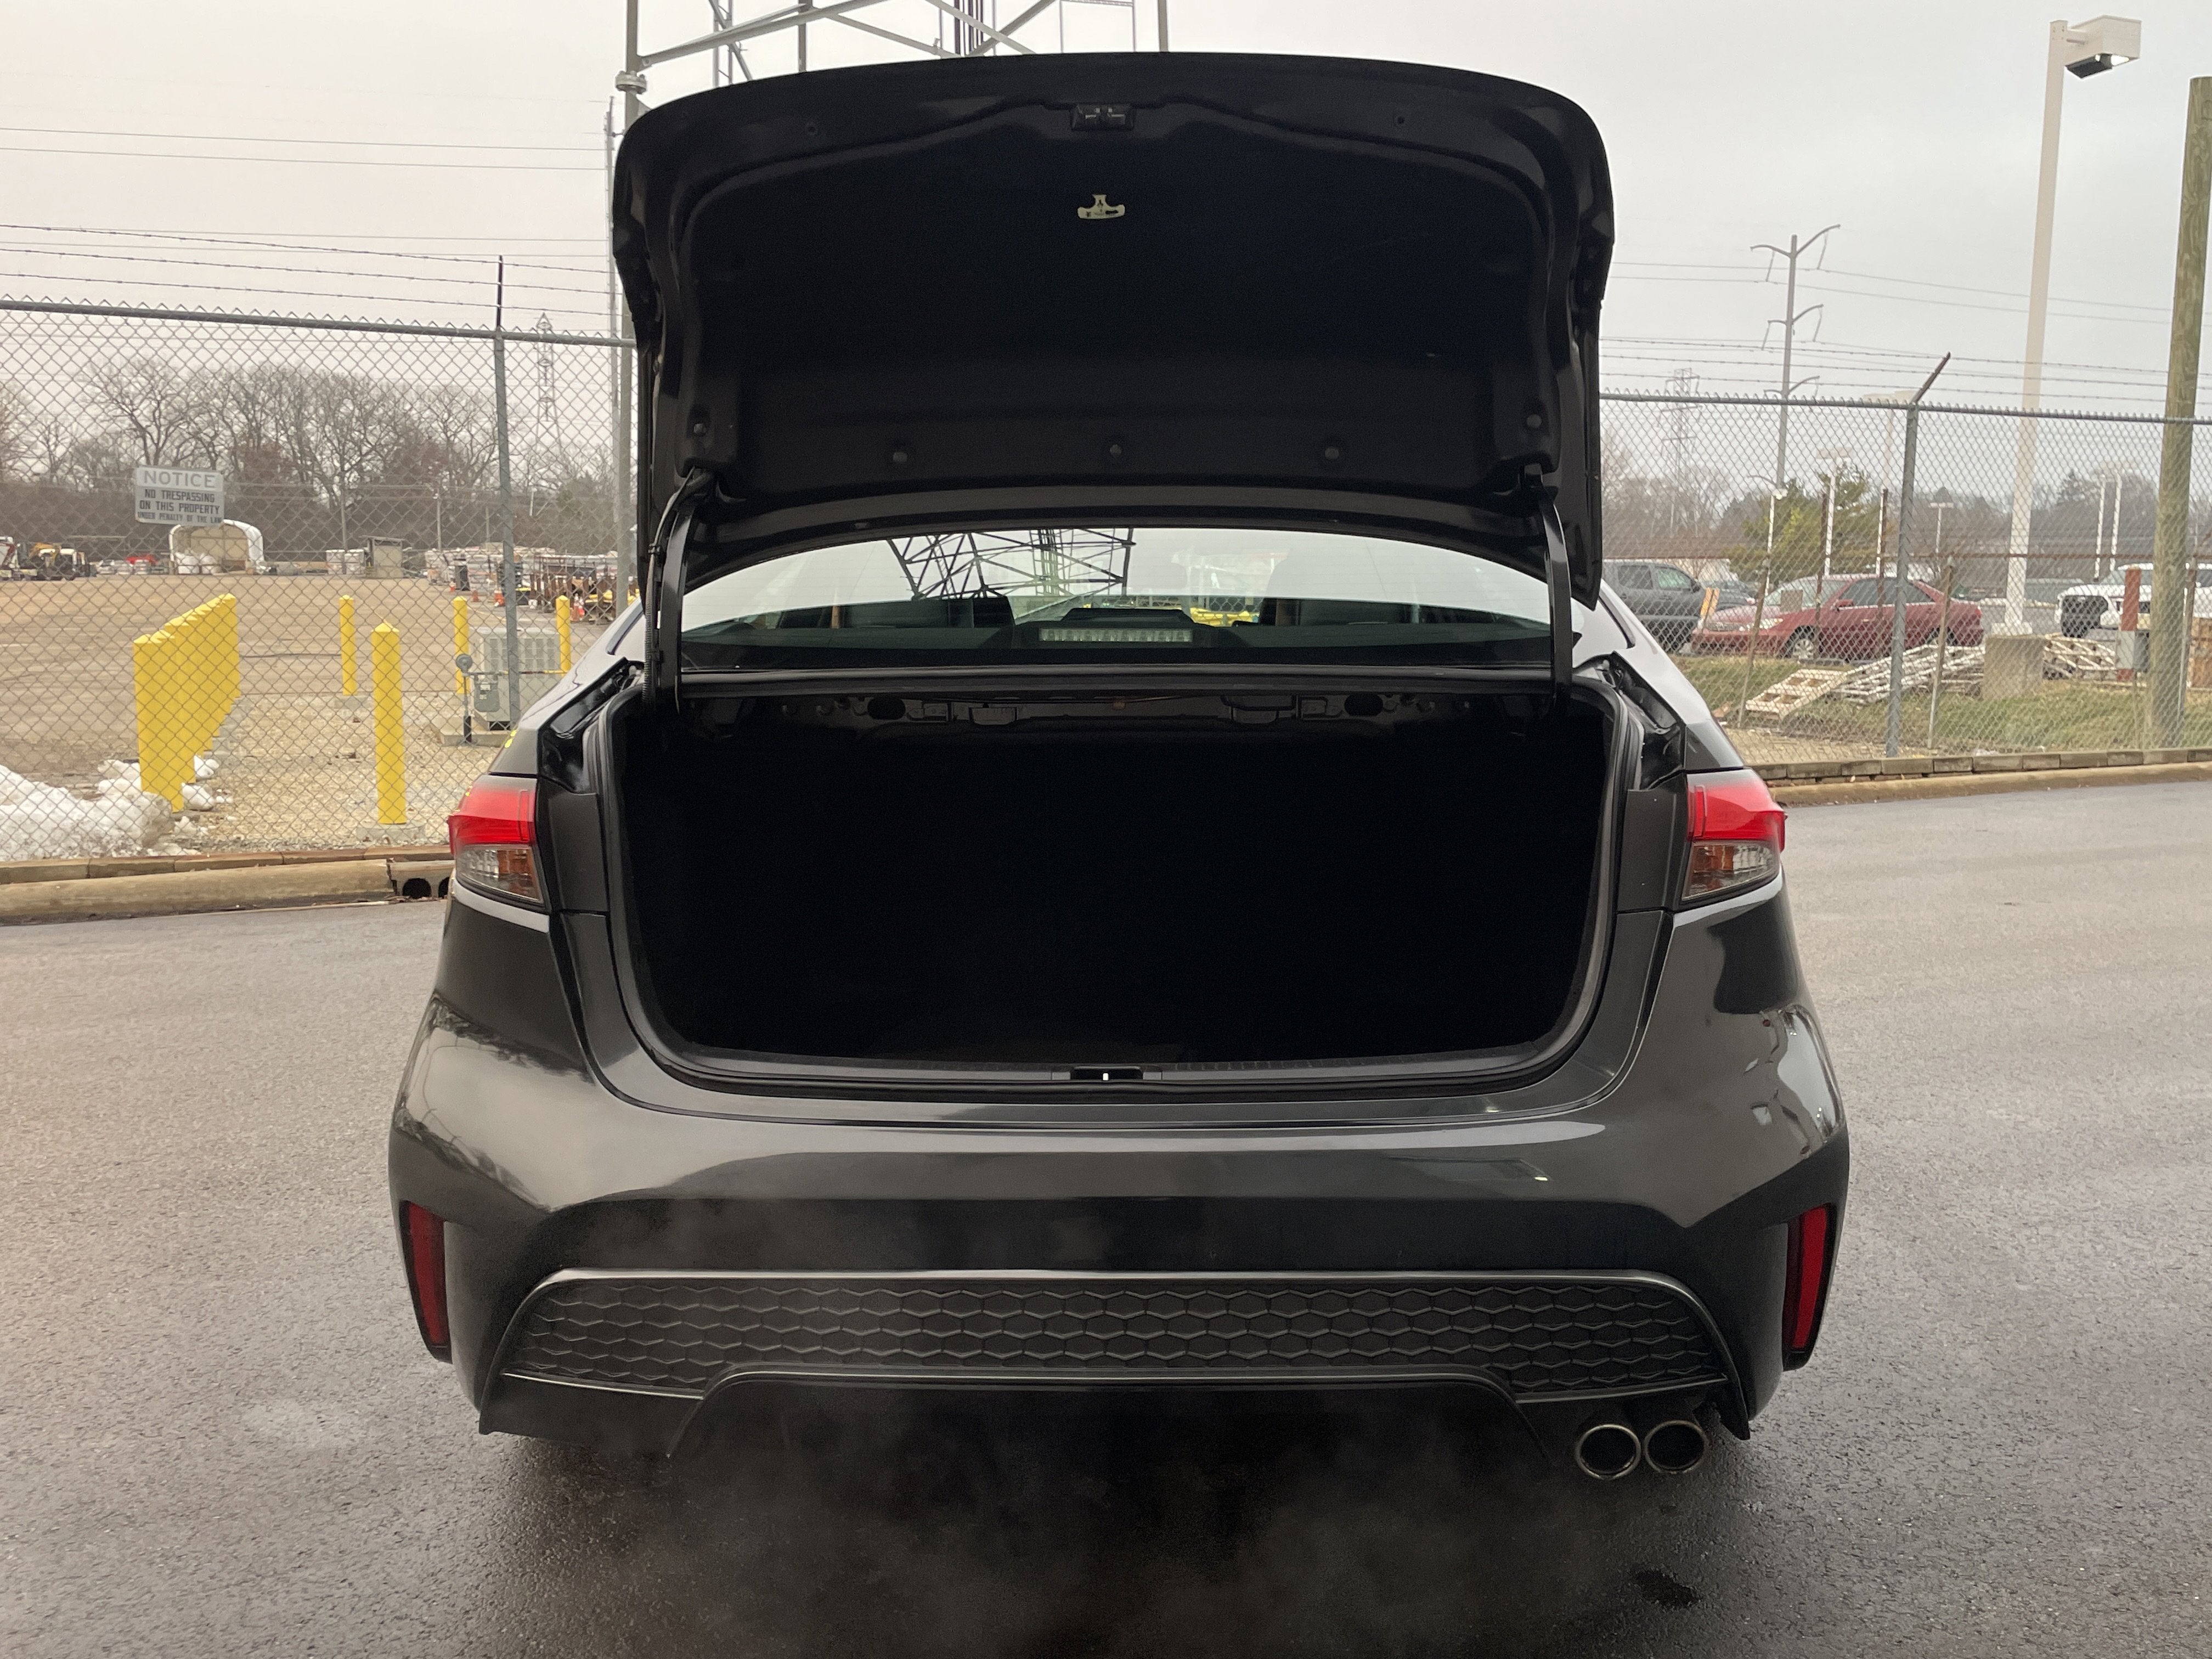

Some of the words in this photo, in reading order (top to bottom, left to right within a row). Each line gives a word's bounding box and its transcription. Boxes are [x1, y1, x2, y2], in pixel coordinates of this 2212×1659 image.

[144, 470, 216, 488] NOTICE
[145, 489, 156, 498] NO
[161, 490, 215, 503] TRESPASSING
[139, 500, 151, 509] ON
[156, 501, 174, 511] THIS
[179, 503, 220, 514] PROPERTY
